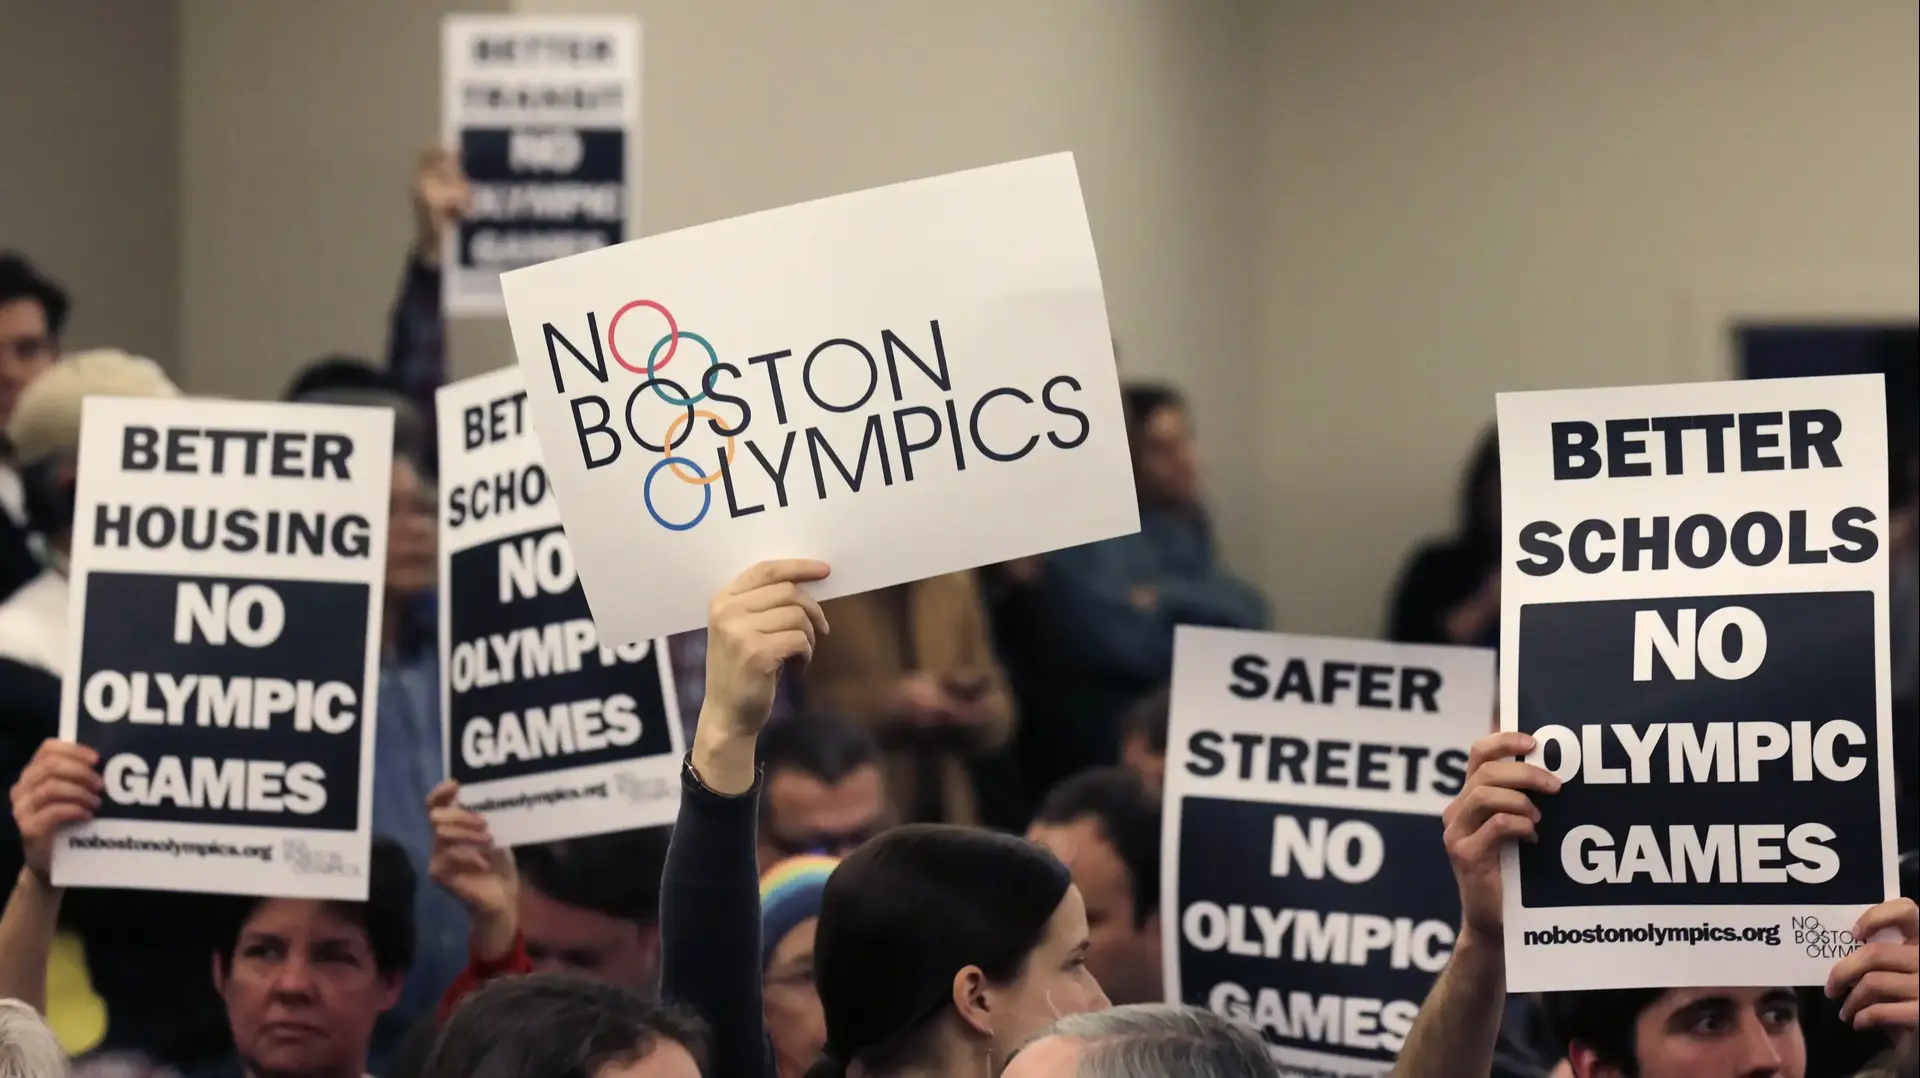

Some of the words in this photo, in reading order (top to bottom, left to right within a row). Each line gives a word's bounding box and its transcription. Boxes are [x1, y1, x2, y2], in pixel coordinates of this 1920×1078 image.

[508, 131, 585, 174] NO
[542, 299, 678, 393] NO
[464, 391, 528, 452] BET
[570, 319, 952, 470] BOSTON
[121, 426, 354, 480] BETTER
[644, 375, 1090, 531] OLYMPICS
[1551, 409, 1843, 480] BETTER
[448, 464, 548, 528] SCHO
[94, 504, 371, 558] HOUSING
[1516, 507, 1880, 576] SCHOOLS
[499, 531, 576, 604] NO
[174, 582, 285, 648] NO
[1633, 606, 1768, 682] NO
[84, 670, 357, 734] OLYMPIC
[1228, 654, 1443, 713] SAFER
[461, 694, 643, 769] GAMES
[1184, 729, 1470, 797] STREETS
[1535, 719, 1868, 785] OLYMPIC
[103, 753, 328, 814] GAMES
[69, 834, 273, 862] nobostonolympics.org
[1270, 814, 1385, 884] NO
[1560, 823, 1841, 884] GAMES
[1182, 900, 1455, 973] OLYMPIC
[1524, 923, 1781, 946] nobostonolympics.org
[1792, 915, 1819, 930] NO
[1806, 943, 1863, 958] OLYM
[1208, 981, 1420, 1053] GAMES
